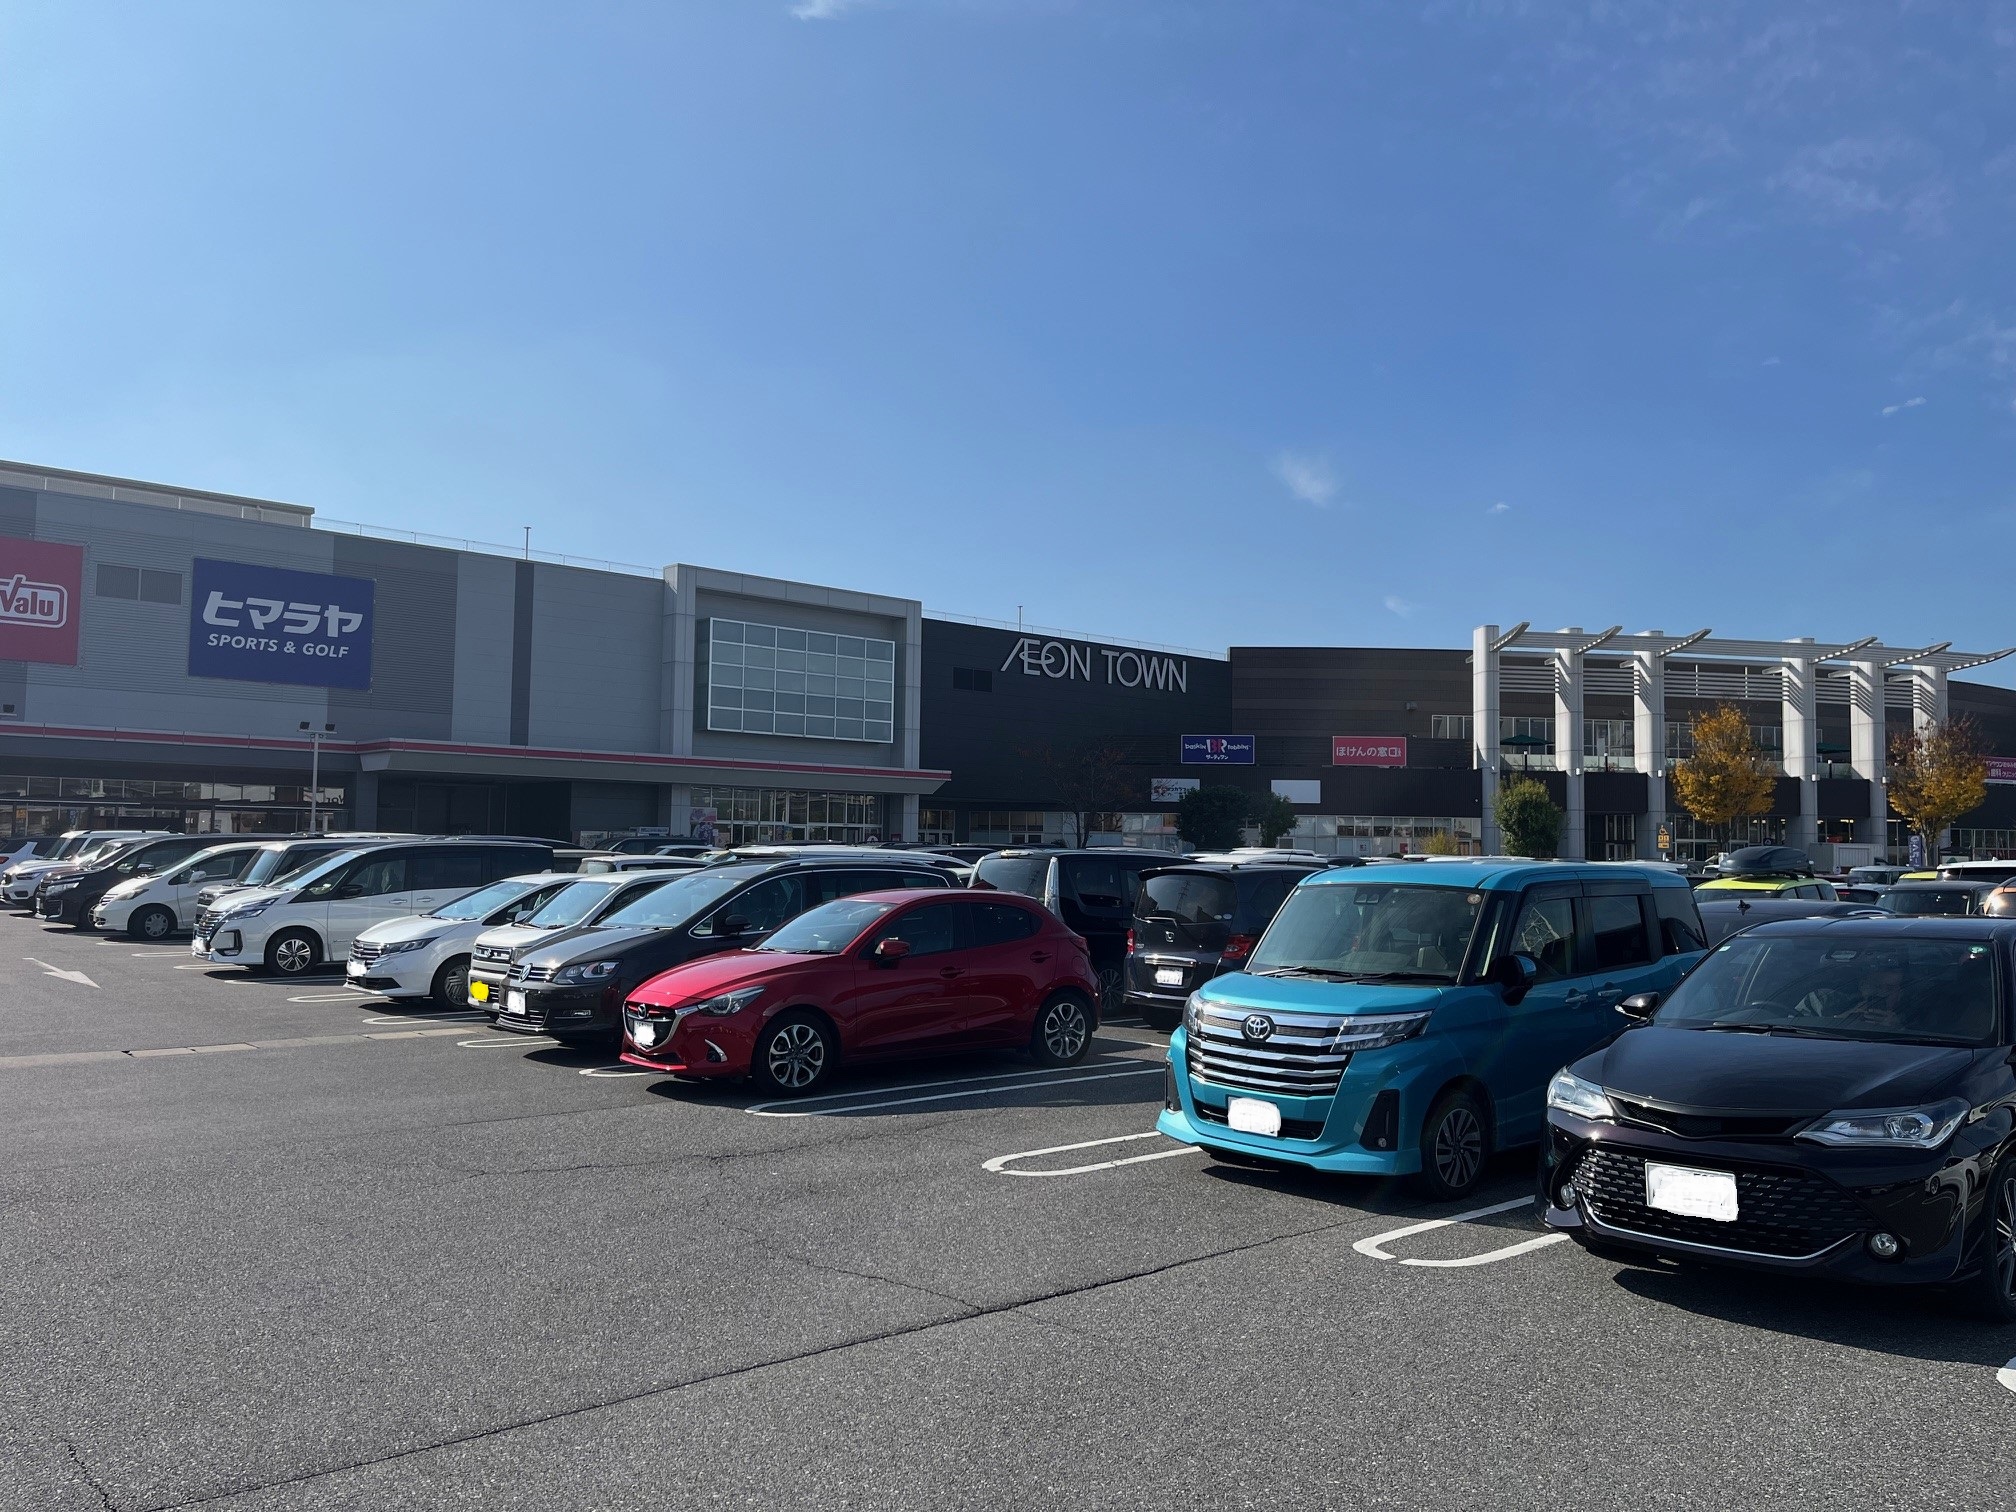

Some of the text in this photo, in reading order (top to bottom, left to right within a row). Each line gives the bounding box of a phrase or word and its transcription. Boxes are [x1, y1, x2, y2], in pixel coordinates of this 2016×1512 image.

[202, 591, 364, 638] ヒマラヤ
[207, 633, 350, 658] SPORTS & GOLF
[1101, 649, 1187, 693] TOWN
[1336, 746, 1399, 757] ほけんの窓口
